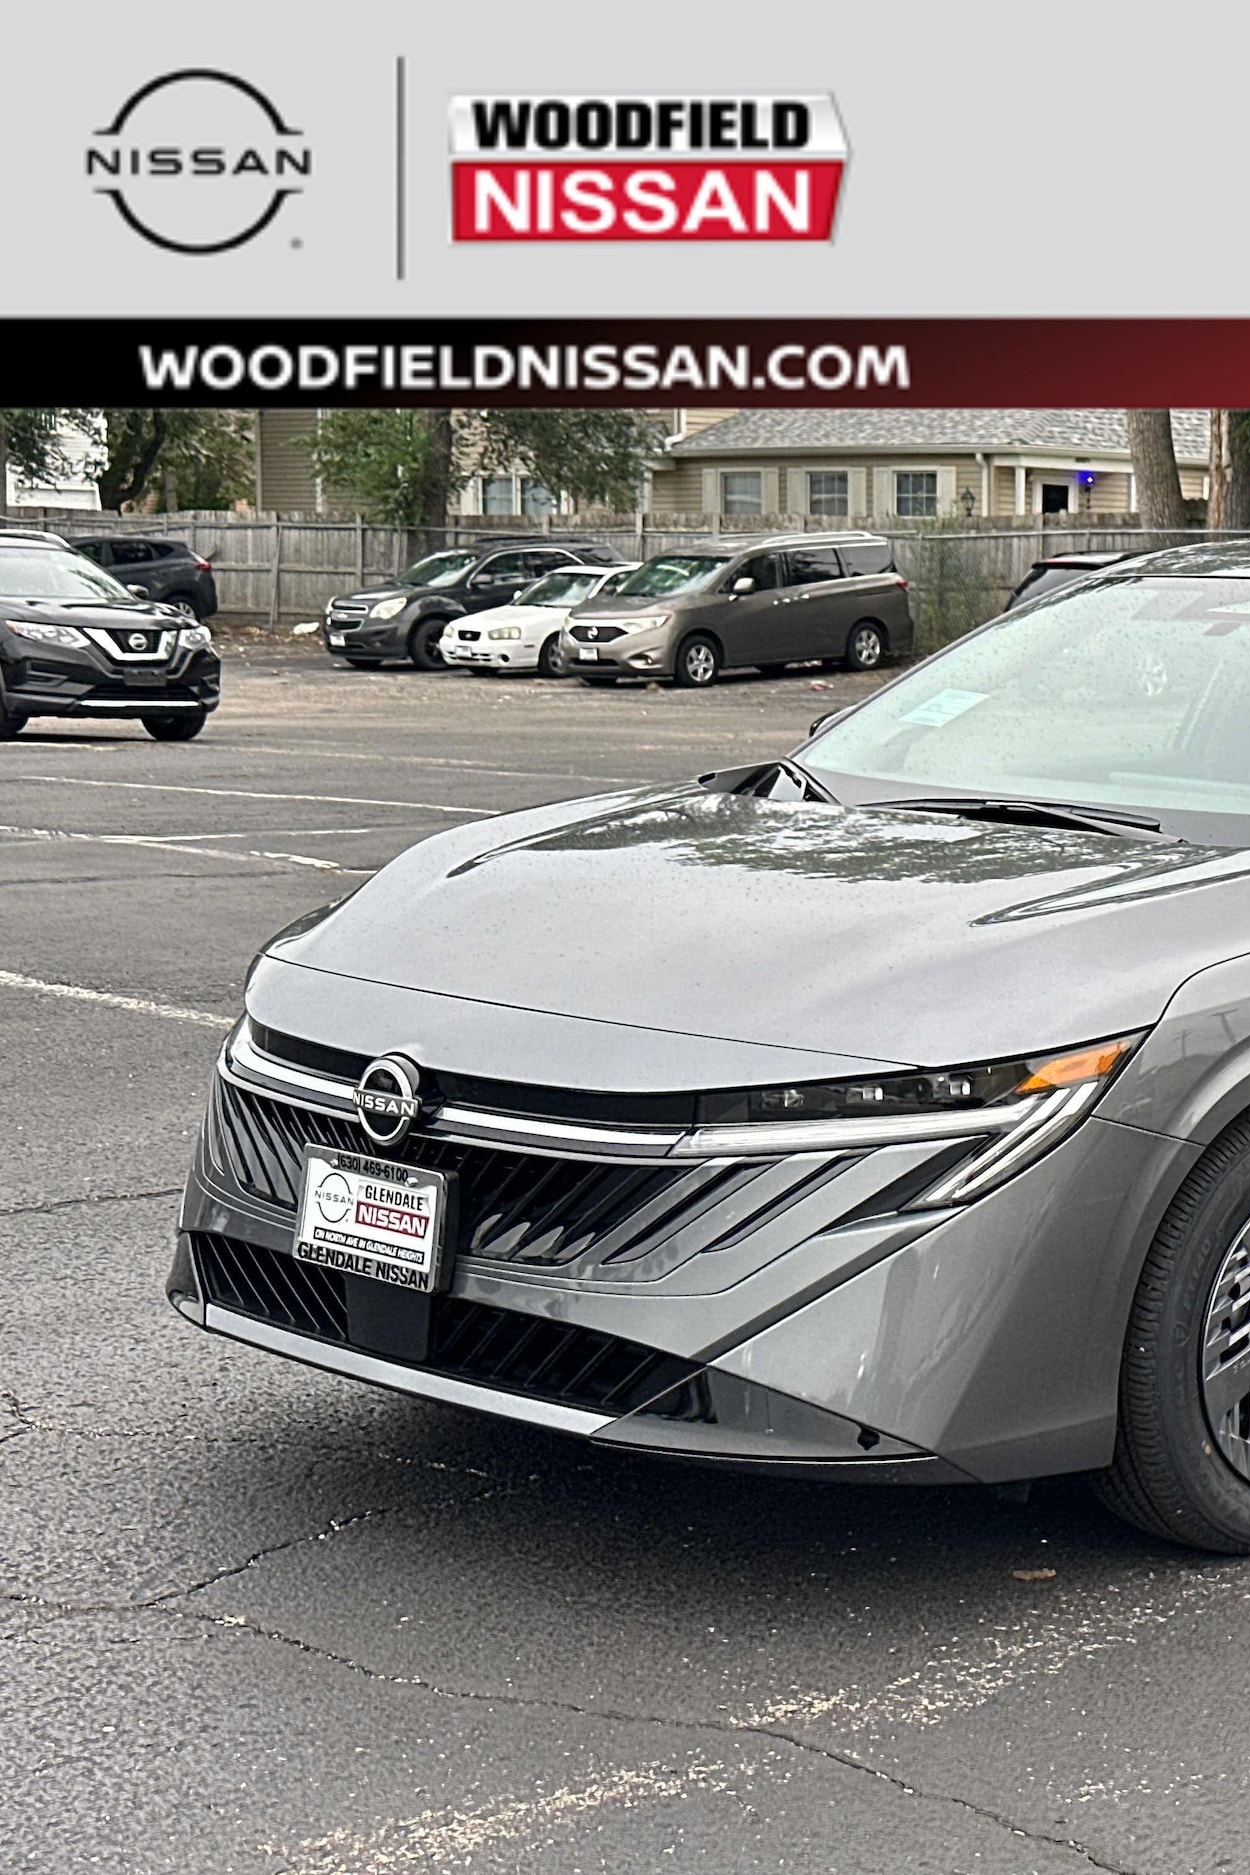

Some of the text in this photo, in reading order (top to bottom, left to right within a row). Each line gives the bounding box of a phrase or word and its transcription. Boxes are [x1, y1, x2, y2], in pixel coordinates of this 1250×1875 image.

[353, 1091, 415, 1116] NISSAN
[362, 1160, 409, 1181] 469-6100
[314, 1190, 354, 1206] NISSAN
[365, 1185, 424, 1211] GLENDALE
[358, 1204, 426, 1237] NISSAN
[325, 1231, 346, 1244] NORTH
[346, 1236, 358, 1247] AVE
[366, 1241, 398, 1256] GLENDALE
[397, 1248, 423, 1263] HEIGHTS
[299, 1242, 430, 1290] GLENDALE NISSAN
